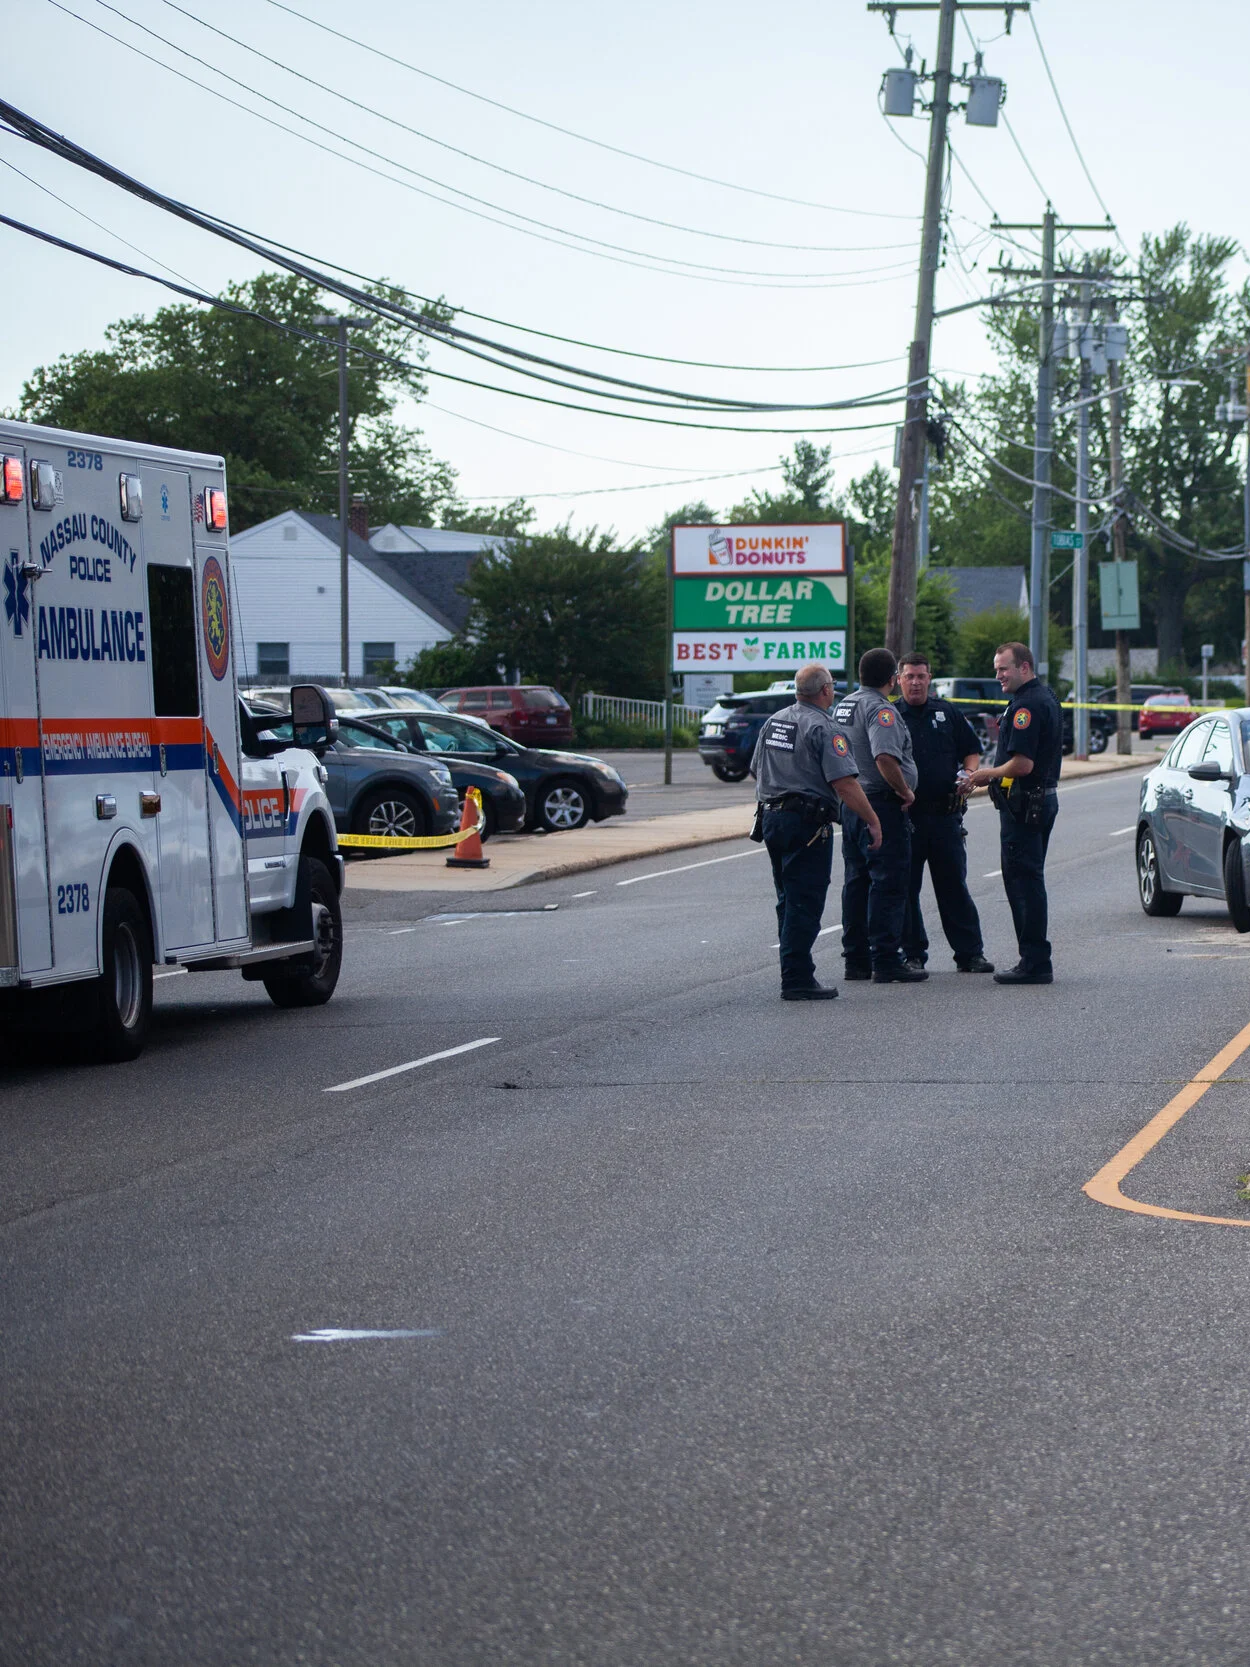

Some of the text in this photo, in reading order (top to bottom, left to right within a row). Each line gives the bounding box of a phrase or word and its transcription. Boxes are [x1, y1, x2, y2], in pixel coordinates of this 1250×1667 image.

[67, 450, 103, 470] 2378
[40, 513, 137, 574] NASSAU COUNTY
[735, 536, 809, 550] DUNKIN'
[69, 555, 112, 582] POLICE
[735, 552, 806, 566] DONUTS
[705, 581, 814, 601] DOLLAR
[725, 604, 793, 624] TREE
[38, 606, 146, 662] AMBULANCE
[677, 641, 842, 660] BEST FARMS
[42, 732, 152, 760] EMERGENCY AMBULANCE BUREAU
[771, 732, 789, 741] MEDIC
[57, 883, 90, 914] 2378
